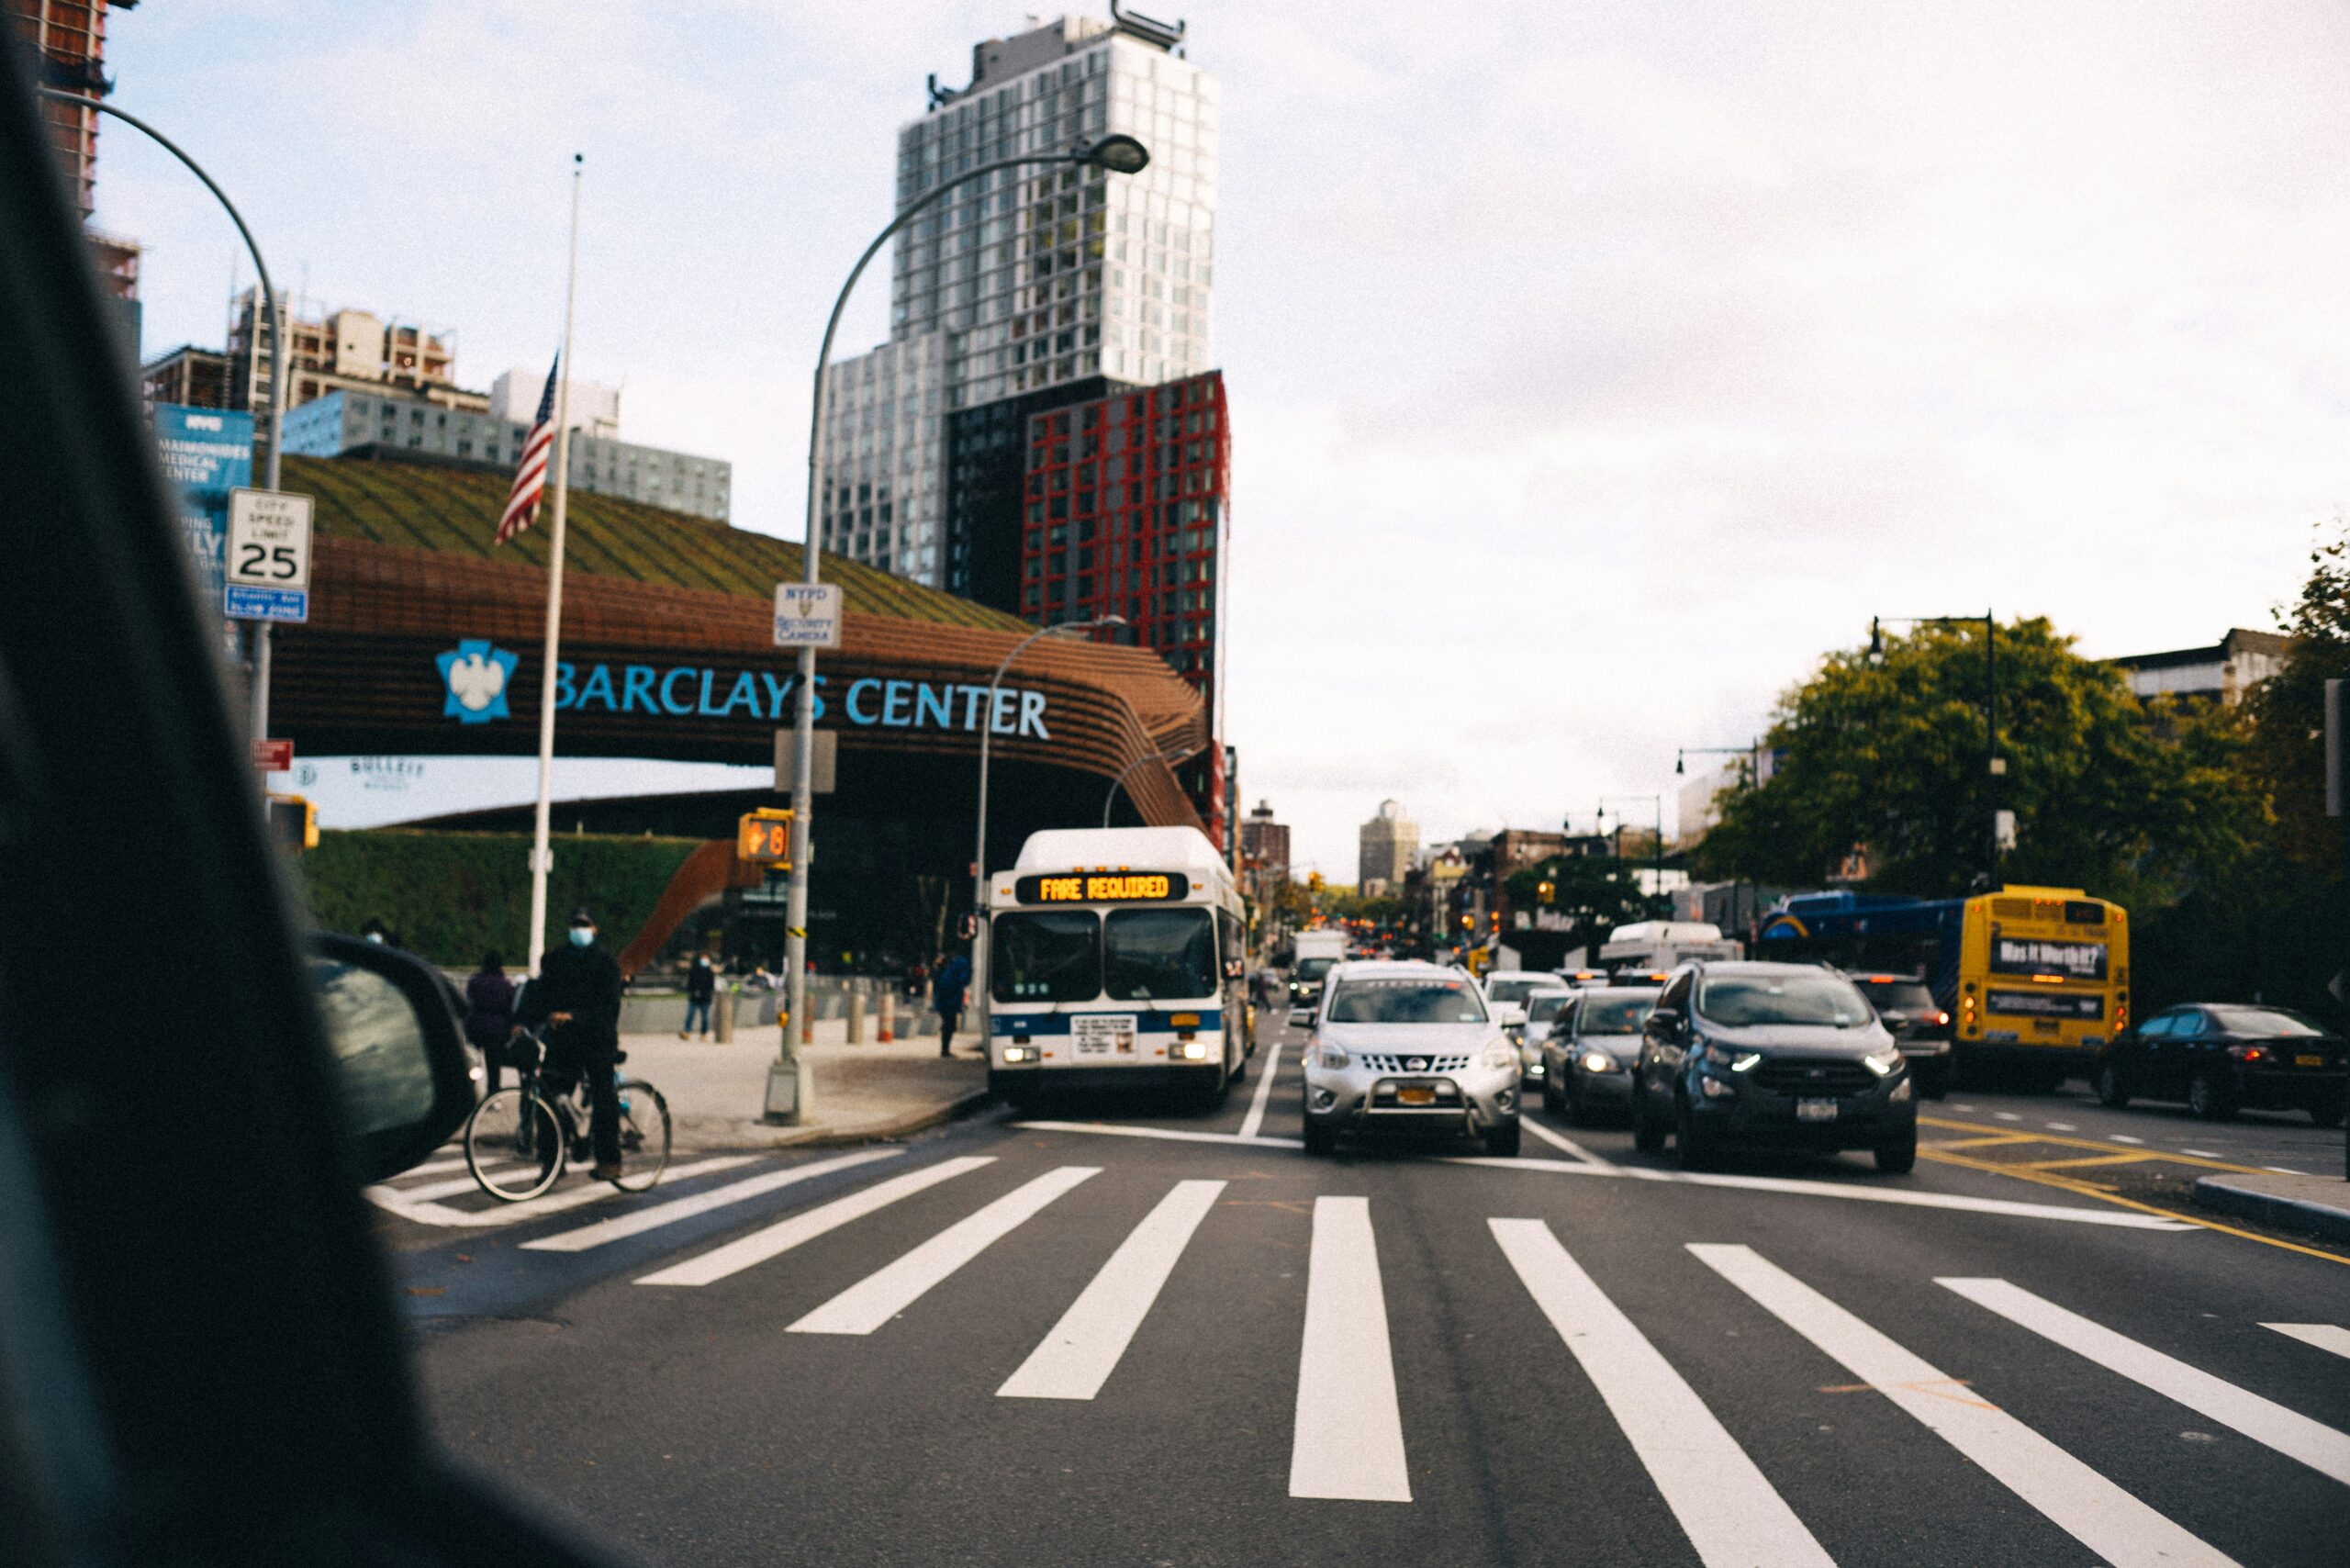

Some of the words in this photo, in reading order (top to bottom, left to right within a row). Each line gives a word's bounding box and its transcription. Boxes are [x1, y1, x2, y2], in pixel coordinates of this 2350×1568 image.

[162, 465, 209, 483] ENTER
[248, 513, 295, 527] SPEED
[251, 530, 288, 541] LIMIT
[240, 543, 297, 579] 25
[786, 588, 827, 601] NYPD
[555, 662, 826, 720] BARCLAYS
[845, 678, 1051, 740] CENTER
[769, 825, 784, 855] 8
[1041, 879, 1082, 901] FARE
[1087, 876, 1169, 900] REQUIRED
